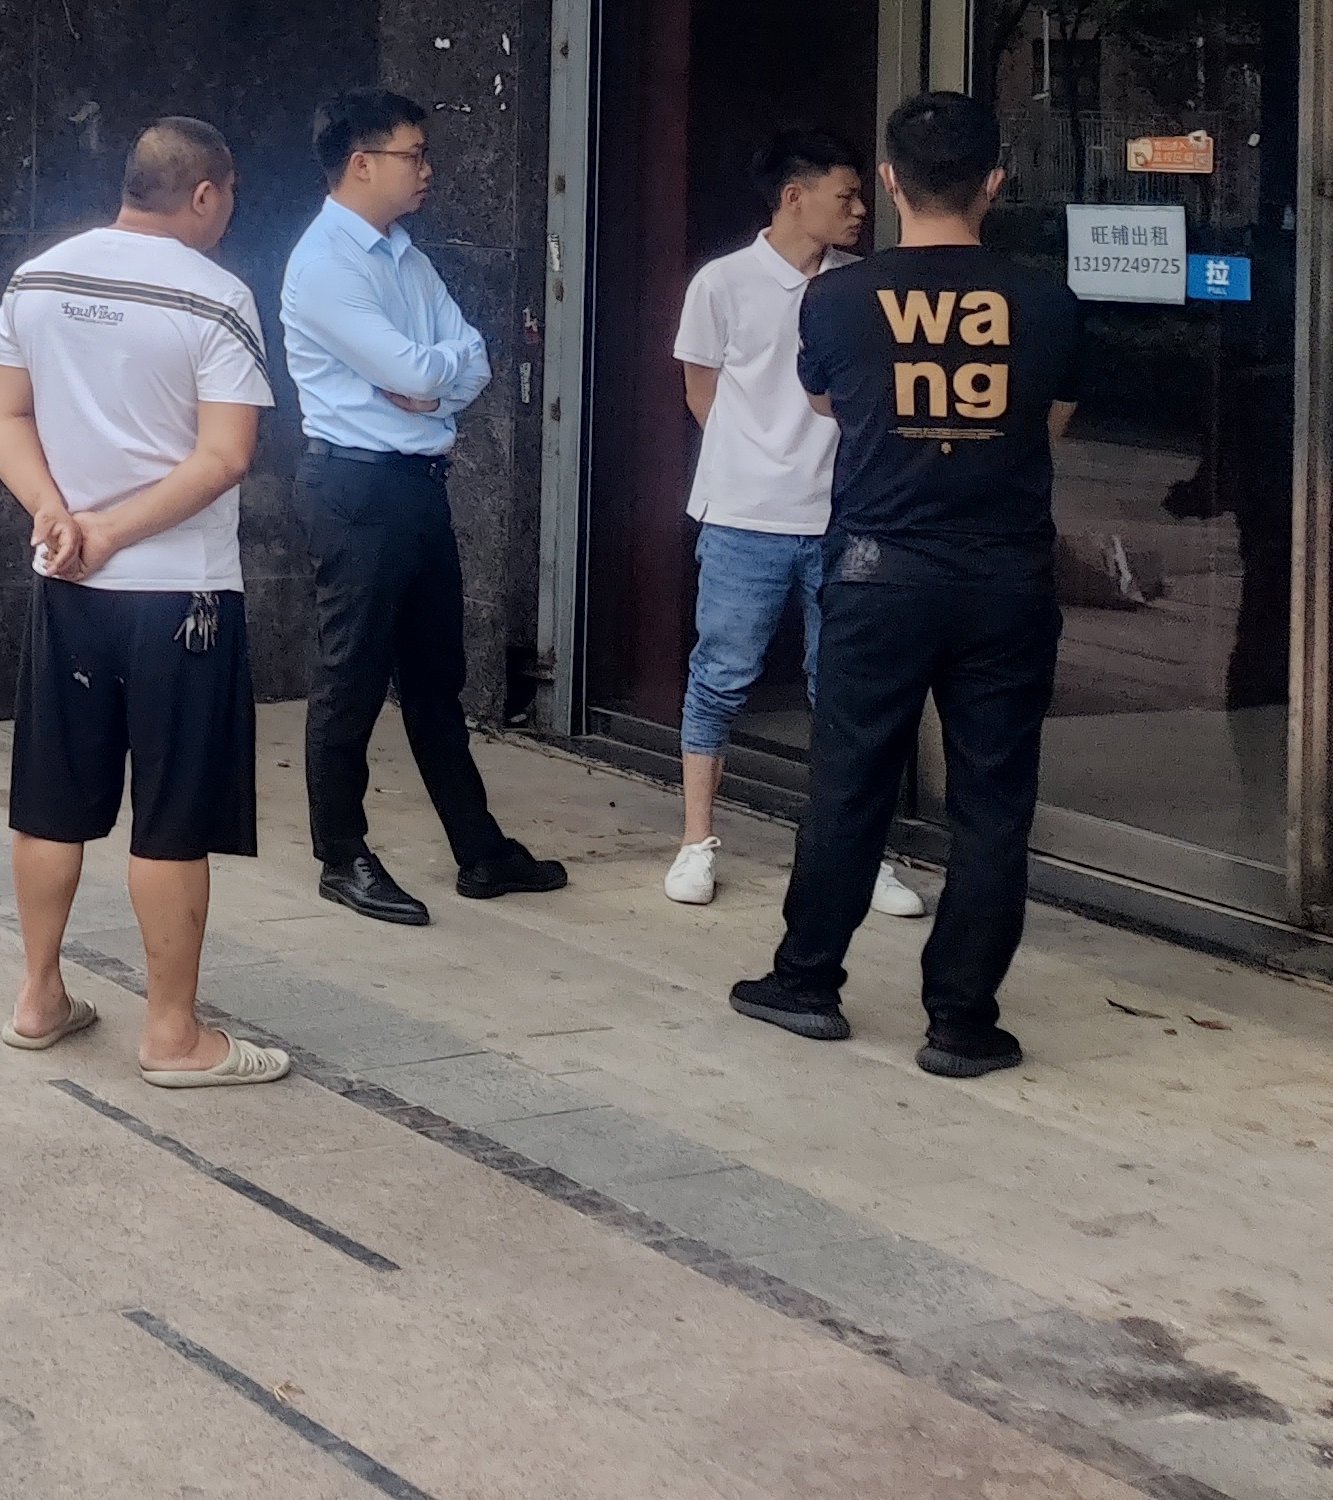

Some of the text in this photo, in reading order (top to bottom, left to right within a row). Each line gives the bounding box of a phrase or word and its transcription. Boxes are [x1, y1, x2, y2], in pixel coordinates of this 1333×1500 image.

[1091, 225, 1169, 247] 旺铺出租
[1074, 256, 1181, 275] 13197249725
[1205, 260, 1230, 285] 拉
[876, 288, 1011, 346] wa
[893, 361, 1009, 419] ng
